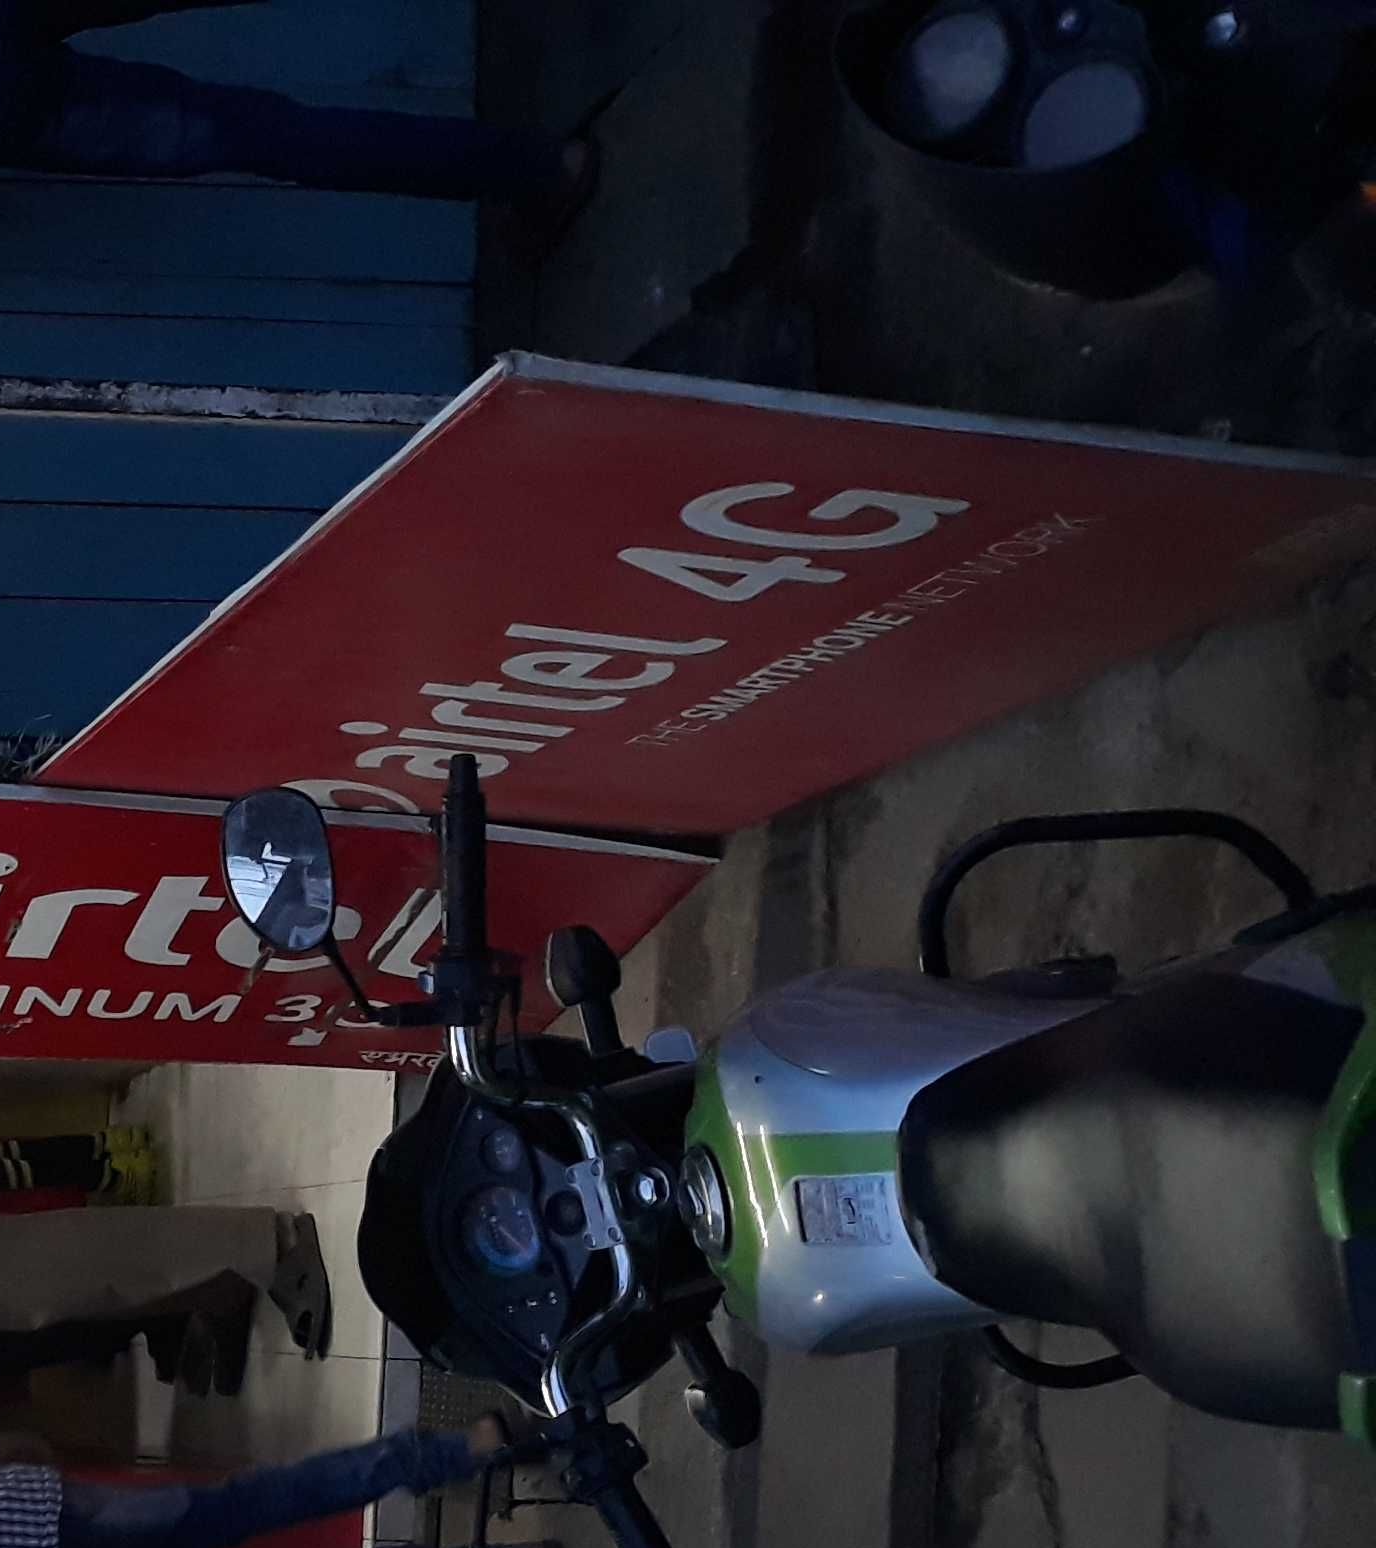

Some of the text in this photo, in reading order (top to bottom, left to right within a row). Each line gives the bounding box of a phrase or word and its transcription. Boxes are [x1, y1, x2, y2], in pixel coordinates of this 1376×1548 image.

[339, 480, 971, 779] airtel 4G
[623, 509, 1105, 744] THE SMARTPHONE NETWORK
